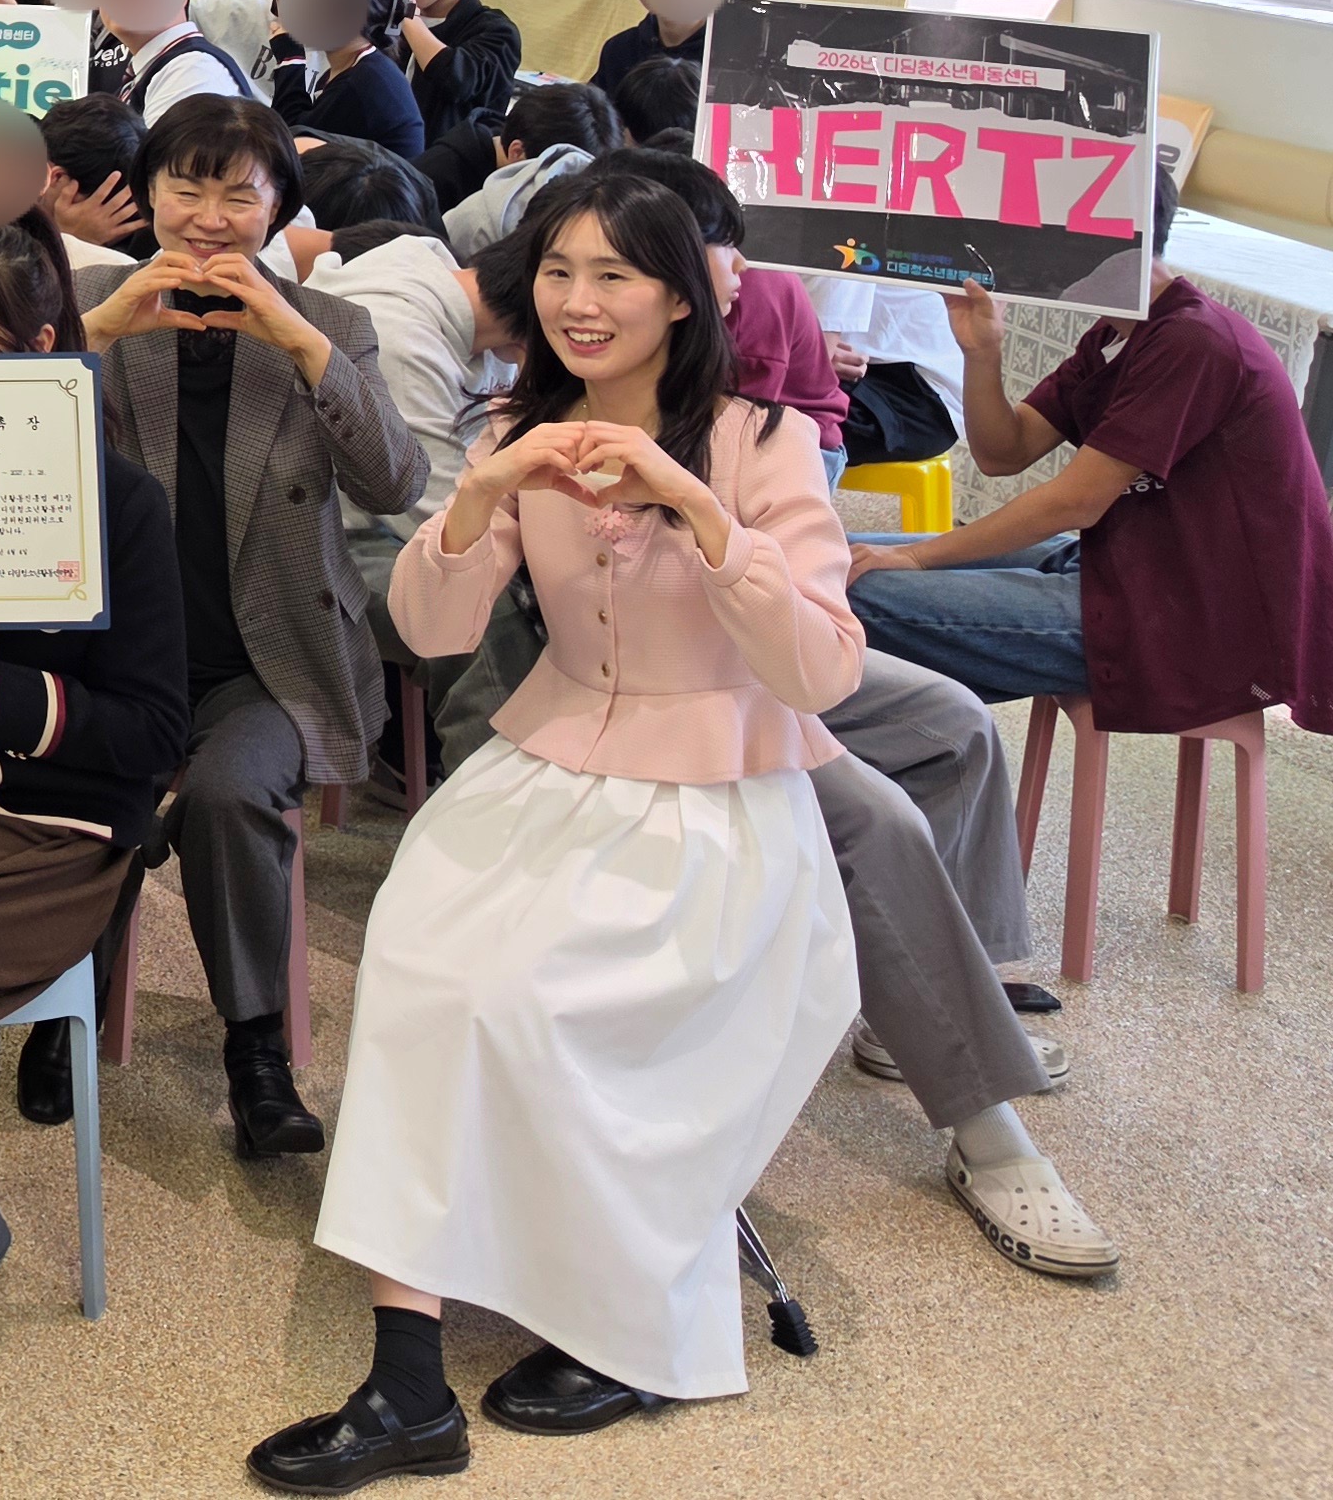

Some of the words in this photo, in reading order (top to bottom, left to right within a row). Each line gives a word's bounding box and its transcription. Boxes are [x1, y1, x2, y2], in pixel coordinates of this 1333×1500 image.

[817, 51, 876, 72] 2026년
[883, 55, 1039, 88] 디딤청소년활동센터
[710, 102, 1137, 240] HERTZ
[975, 1206, 1032, 1261] crocs
